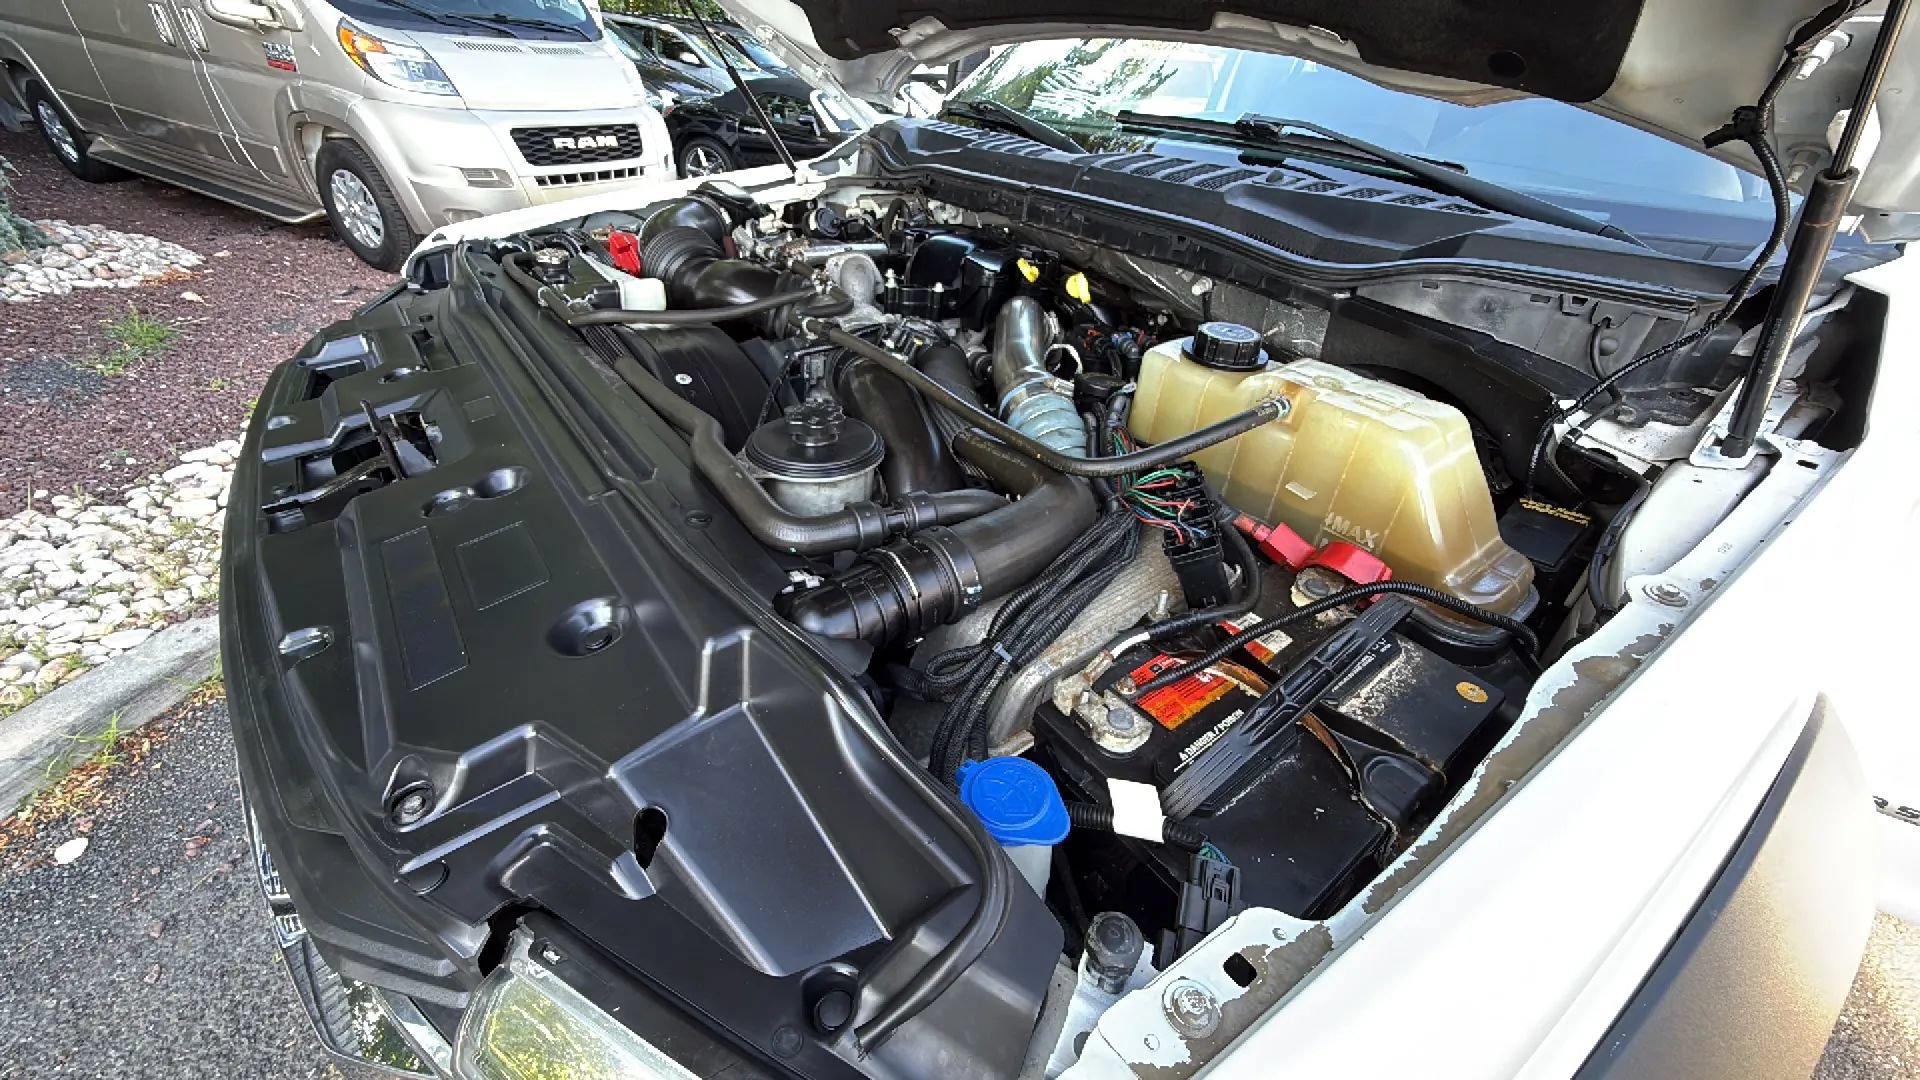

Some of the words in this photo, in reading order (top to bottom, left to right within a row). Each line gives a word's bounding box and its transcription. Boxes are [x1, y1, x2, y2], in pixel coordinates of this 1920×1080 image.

[552, 135, 619, 149] RAM
[1332, 515, 1380, 549] MAX
[1184, 731, 1214, 757] DANGER
[1217, 708, 1245, 731] POISON
